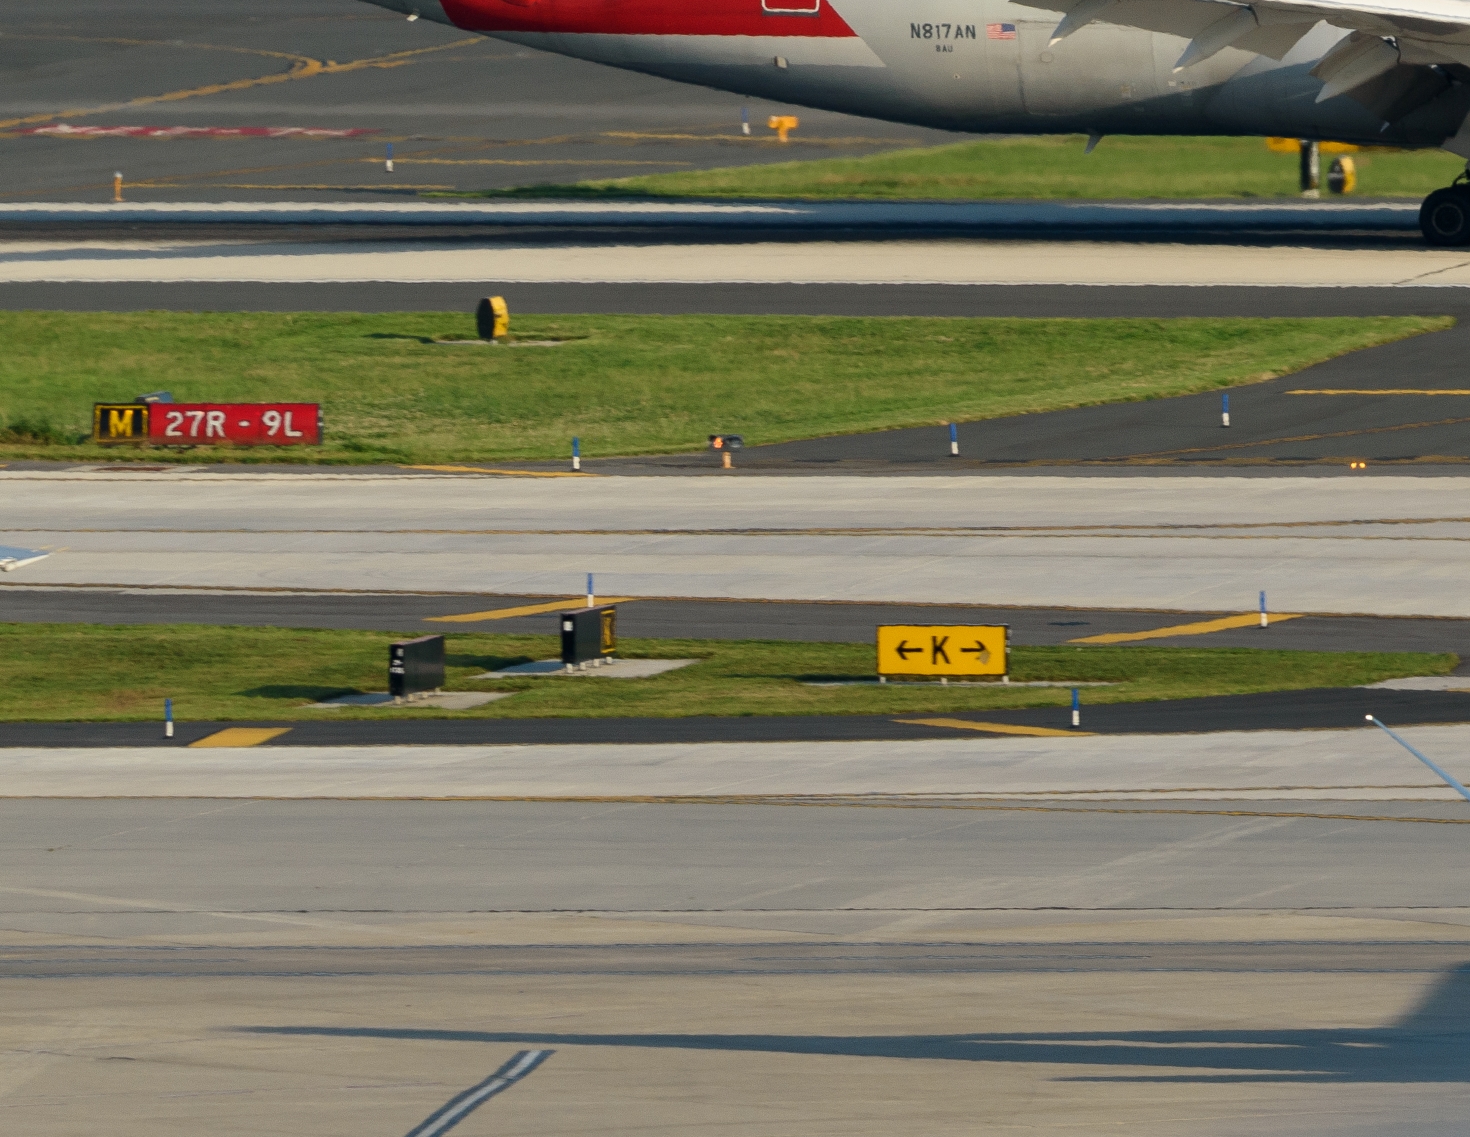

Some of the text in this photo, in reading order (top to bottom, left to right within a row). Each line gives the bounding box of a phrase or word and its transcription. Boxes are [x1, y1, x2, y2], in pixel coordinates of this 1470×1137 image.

[910, 22, 976, 40] N817AN
[108, 409, 134, 438] M
[164, 410, 227, 438] 27R
[261, 410, 304, 437] 9L
[931, 635, 952, 665] K
